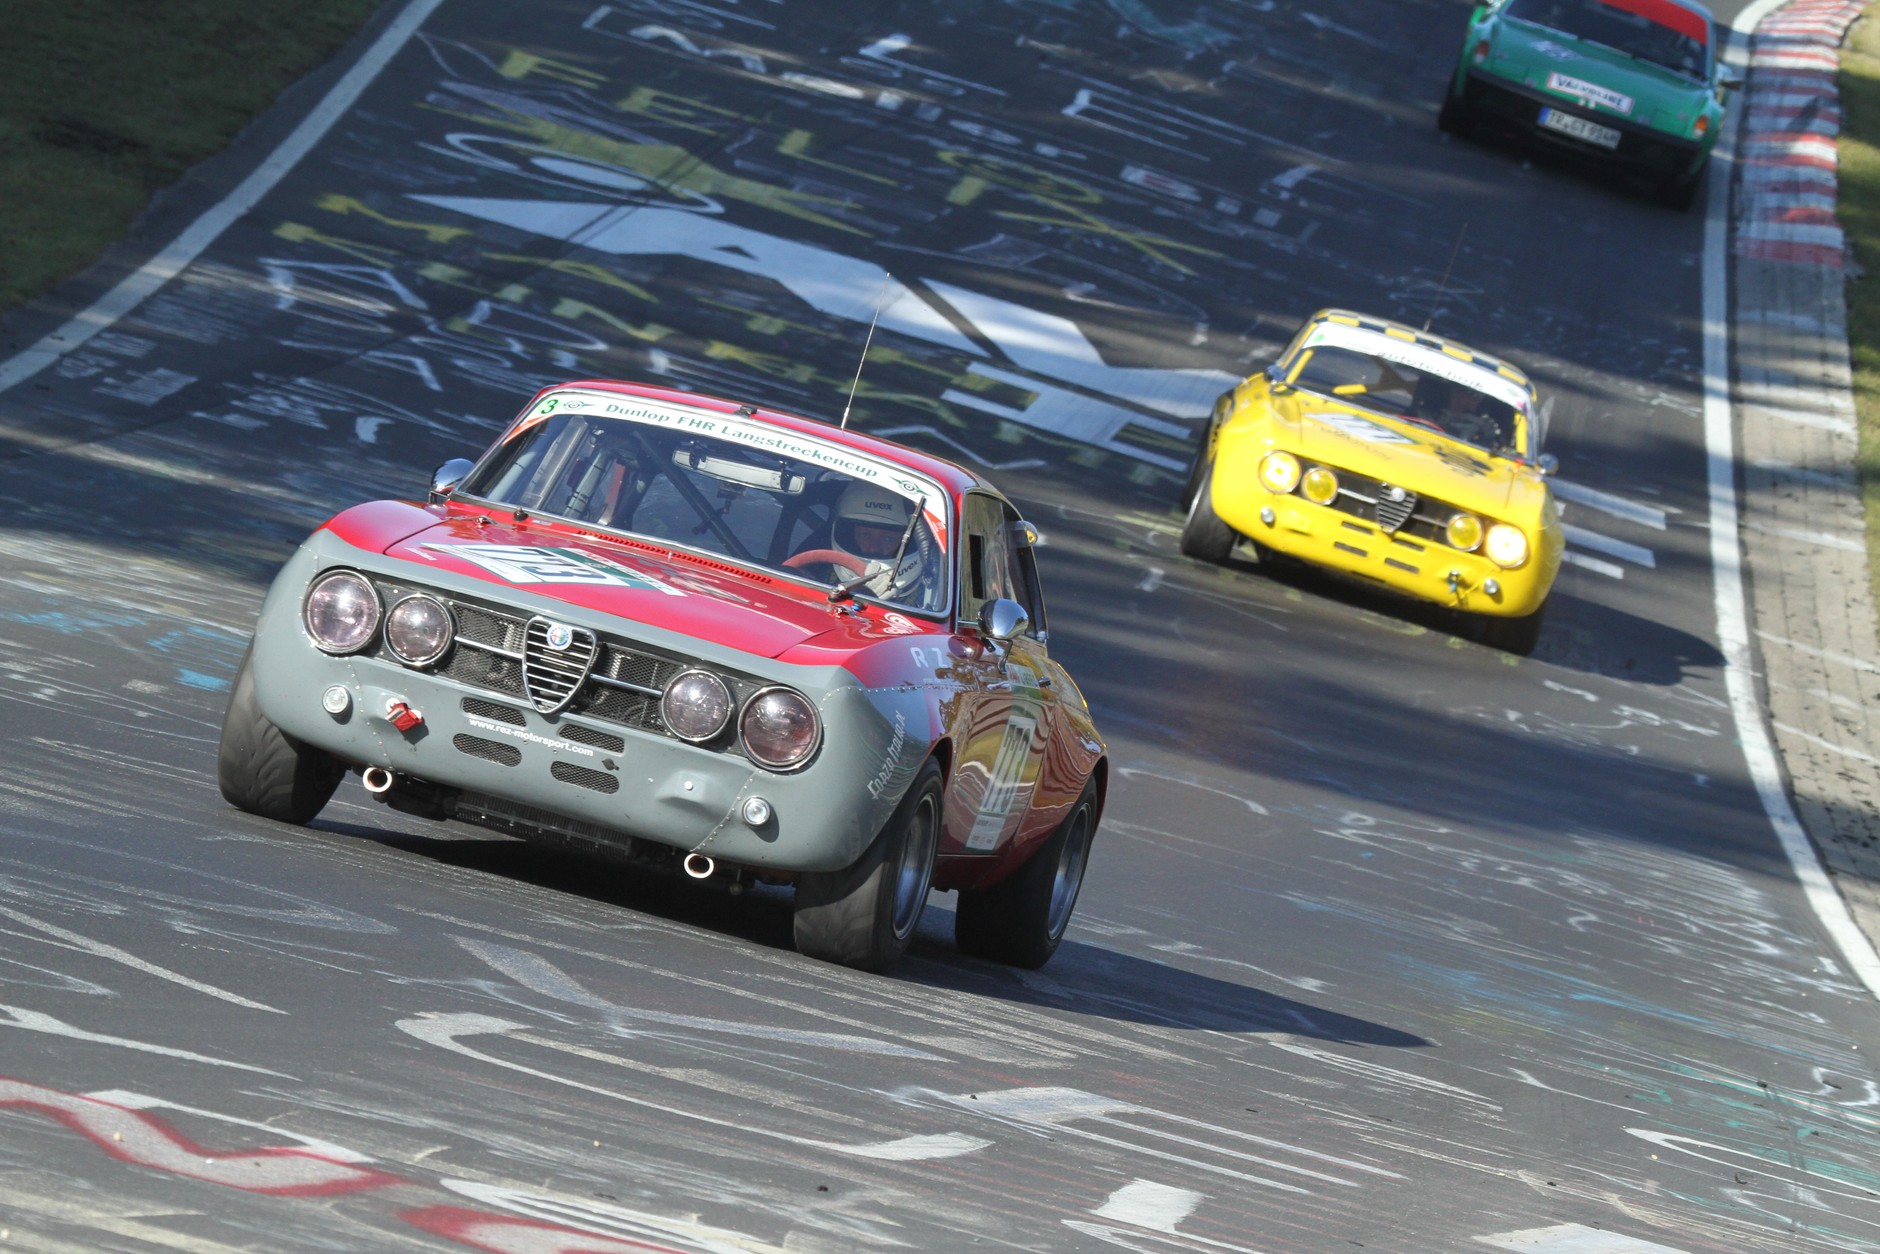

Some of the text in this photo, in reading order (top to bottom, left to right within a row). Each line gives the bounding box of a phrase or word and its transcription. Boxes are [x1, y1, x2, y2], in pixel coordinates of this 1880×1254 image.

[540, 398, 559, 415] 3
[605, 403, 878, 478] Dunlop FHR Langstreckencup
[864, 501, 893, 511] uvex
[465, 547, 608, 580] 773
[897, 559, 919, 577] uvex
[468, 718, 594, 757] www.rez-motorsport.com
